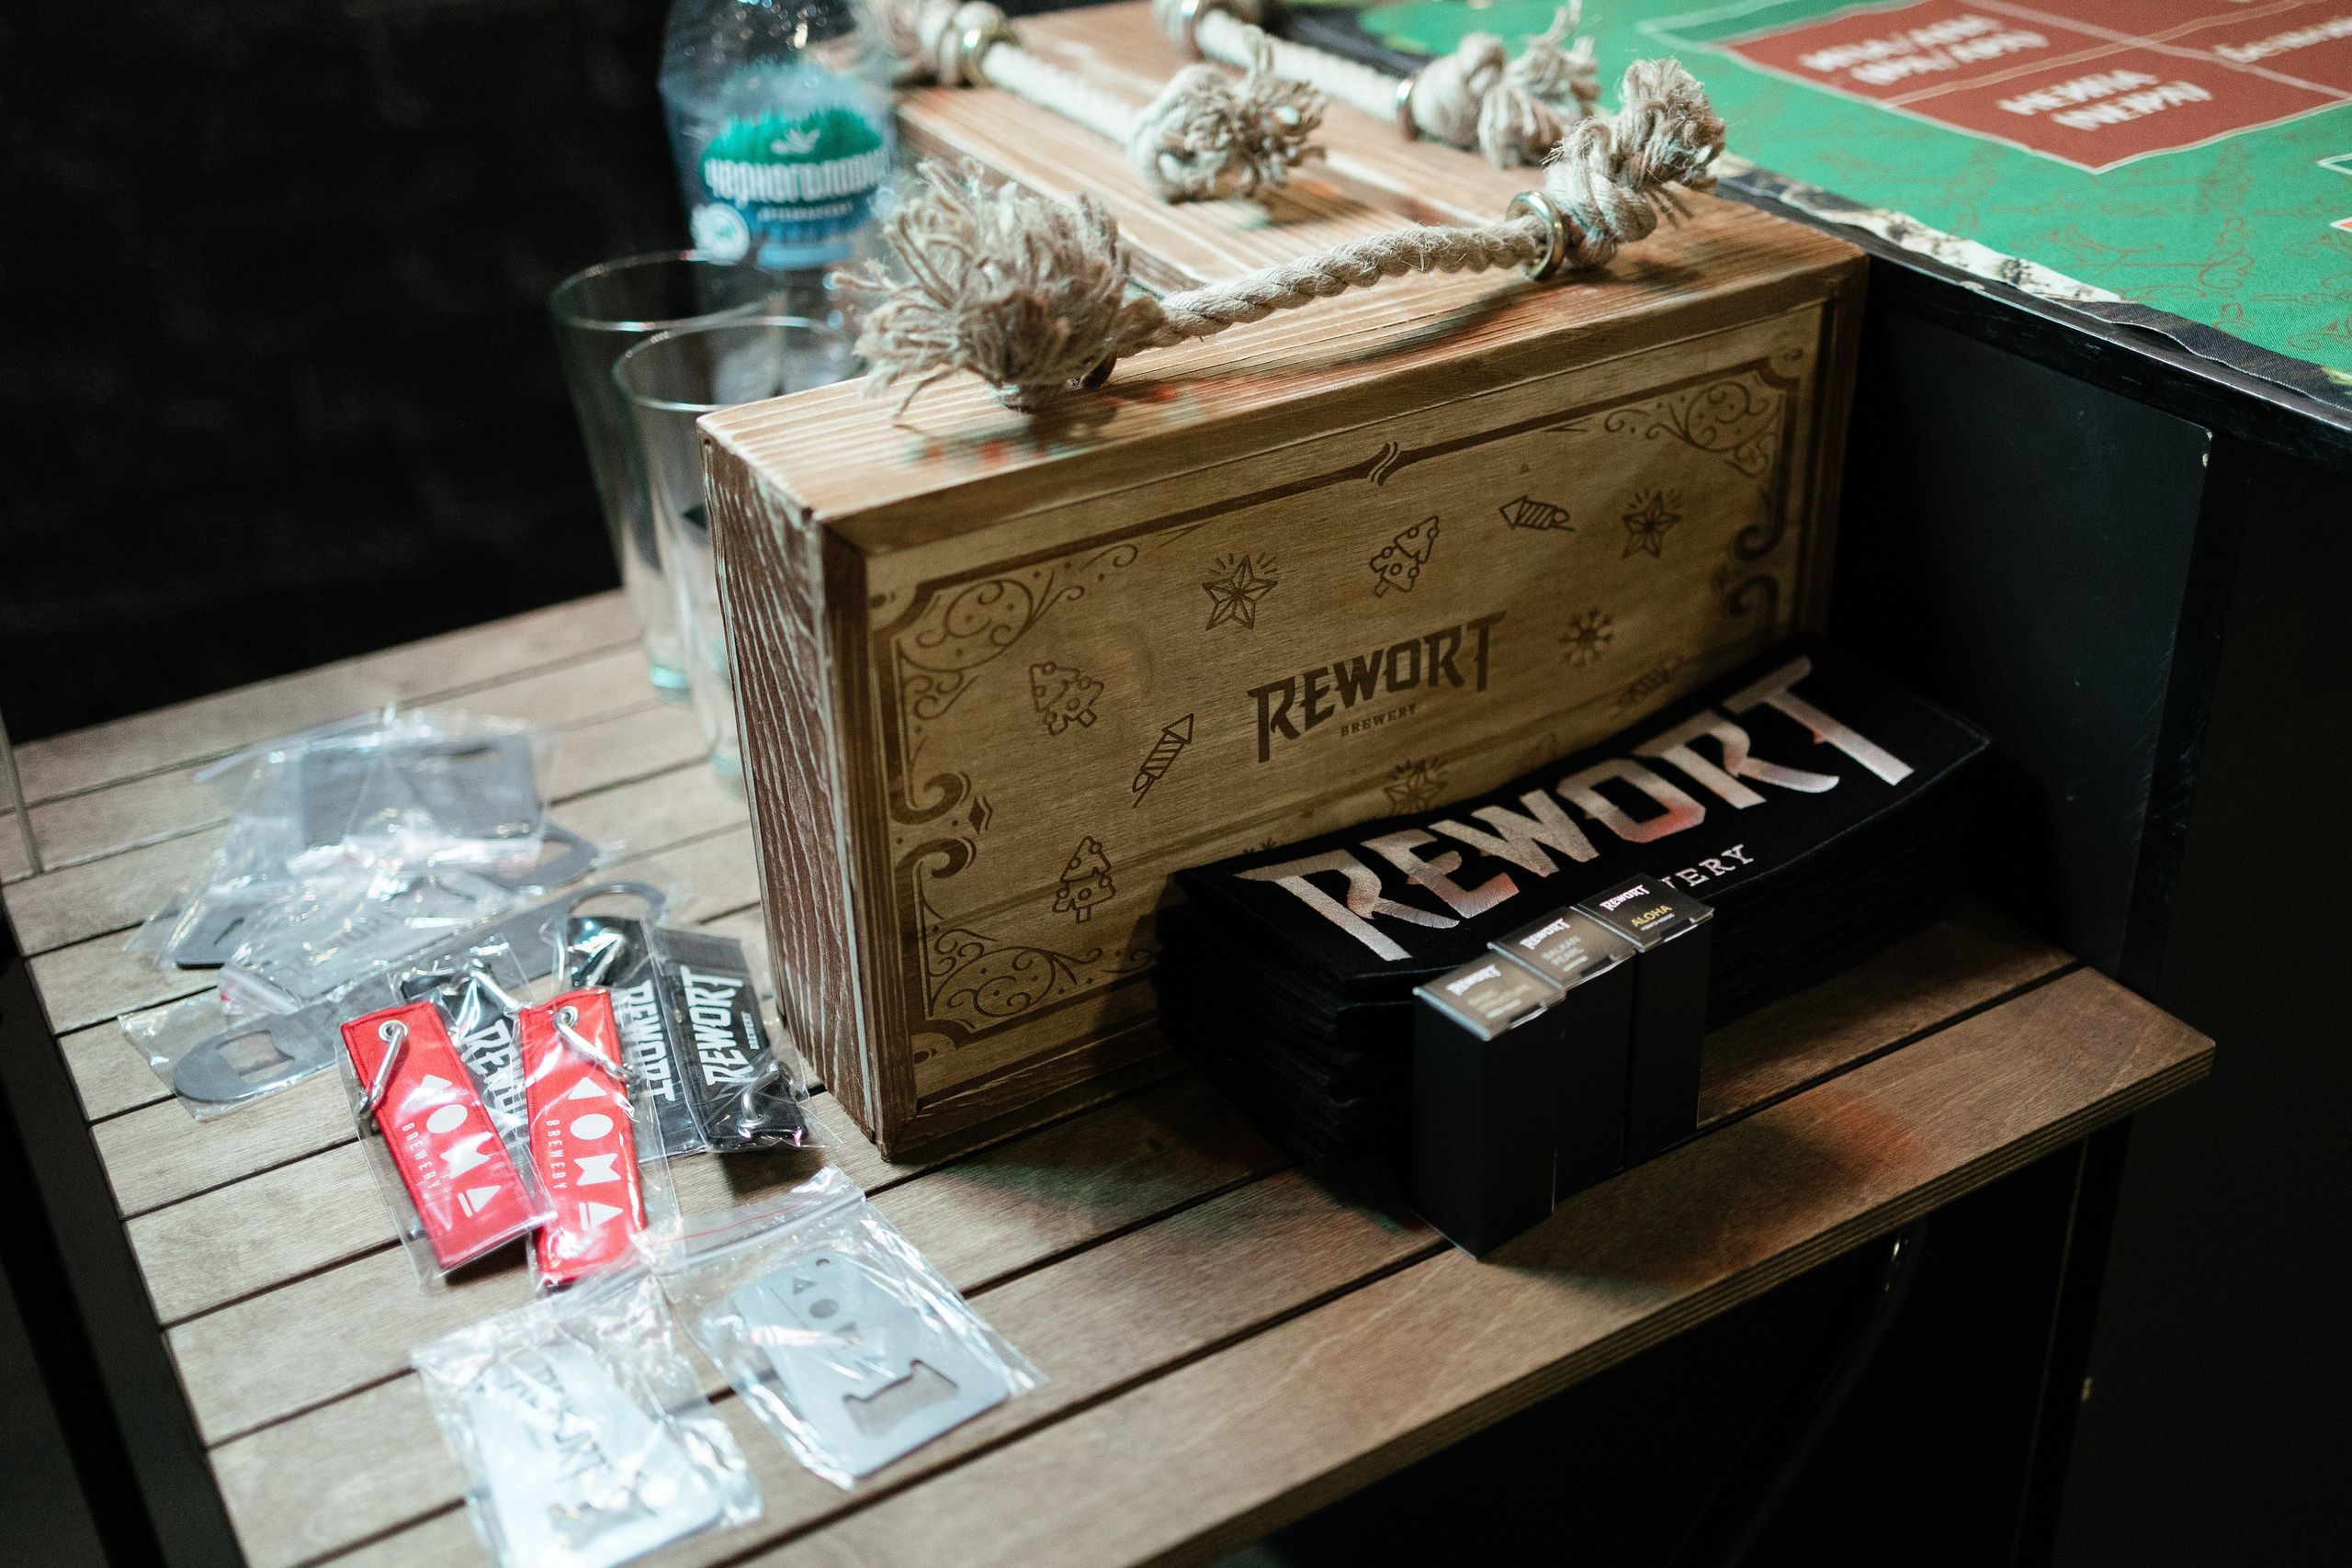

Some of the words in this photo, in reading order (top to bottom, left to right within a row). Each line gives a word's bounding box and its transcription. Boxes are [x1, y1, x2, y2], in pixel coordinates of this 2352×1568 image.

[1247, 610, 1508, 763] REWORT
[1340, 703, 1419, 738] BREWERY
[1231, 655, 1915, 962] REWORT
[1600, 885, 1650, 912] REWORT
[1631, 904, 1673, 929] ALOHA
[1519, 918, 1570, 950] REWORT
[679, 964, 759, 1087] REWORT
[401, 1122, 442, 1190] BREWERY
[546, 1119, 568, 1190] BREWERY
